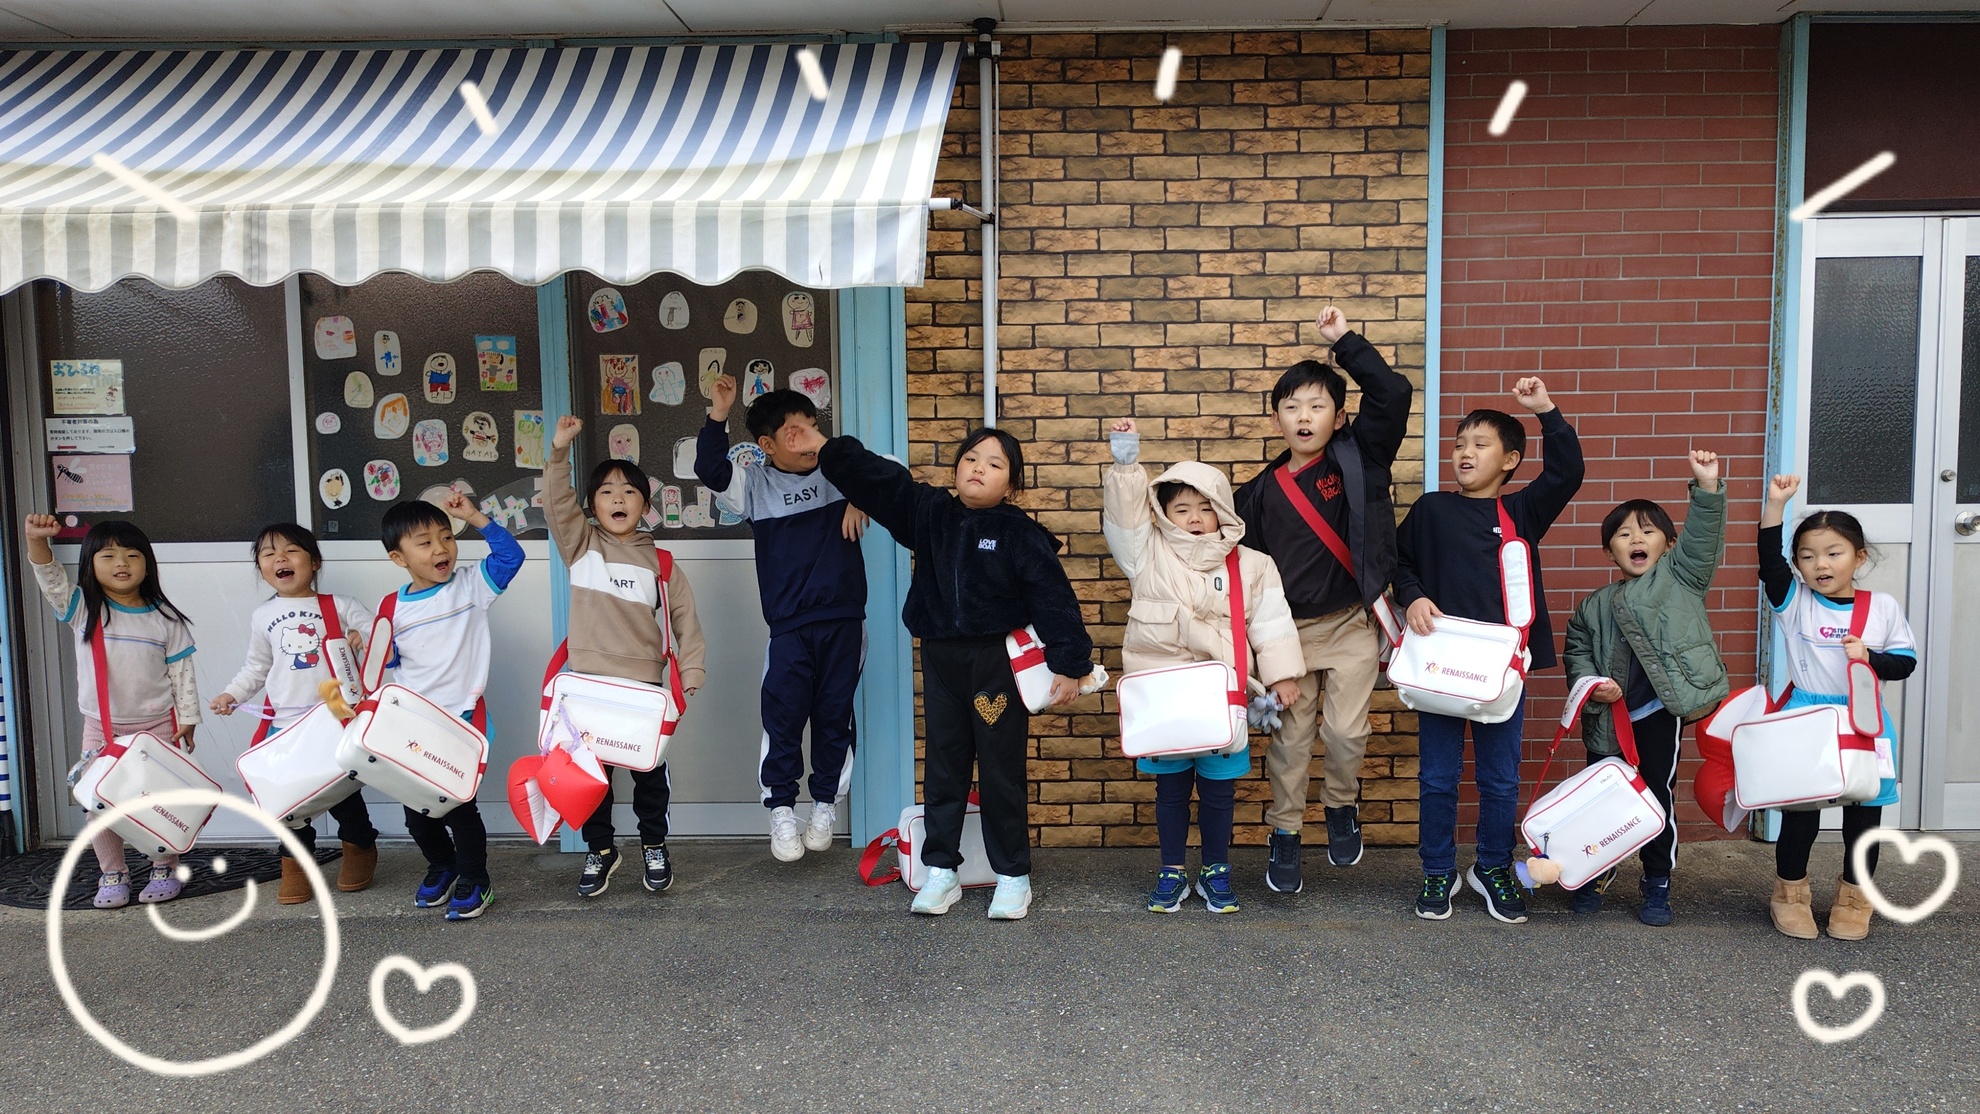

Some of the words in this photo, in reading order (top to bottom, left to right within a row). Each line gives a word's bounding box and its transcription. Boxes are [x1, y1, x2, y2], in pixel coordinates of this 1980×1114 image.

[53, 361, 101, 377] おひるね
[783, 485, 818, 506] EASY
[267, 611, 296, 633] HELLO
[338, 646, 355, 683] RENAISSANCE
[1441, 667, 1488, 683] RENAISSANCE
[595, 736, 642, 752] RENAISSANCE
[423, 750, 466, 780] RENAISSANCE
[151, 803, 190, 834] RENAISSANCE
[1598, 815, 1642, 848] RENAISSANCE
